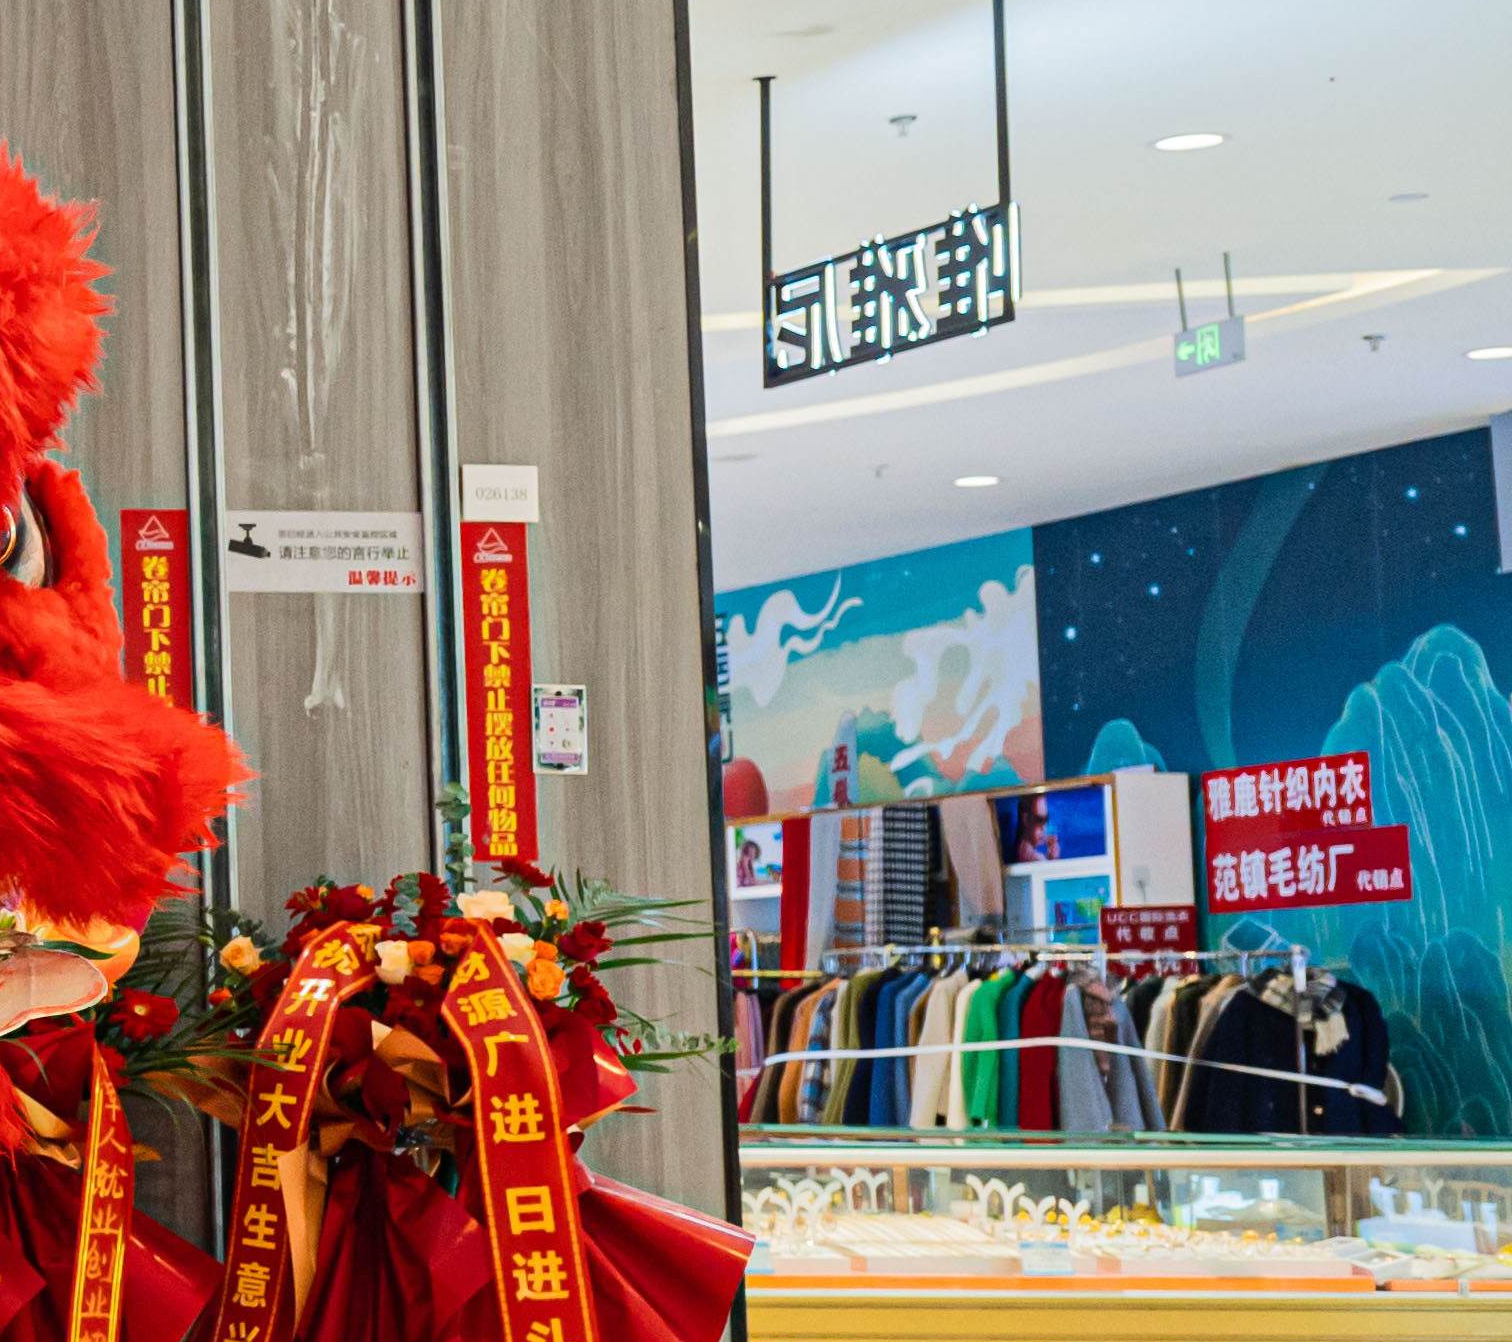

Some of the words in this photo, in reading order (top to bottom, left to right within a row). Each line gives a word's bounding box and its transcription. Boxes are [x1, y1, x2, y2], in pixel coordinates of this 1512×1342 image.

[475, 487, 529, 502] 026138
[279, 545, 410, 561] 请注意您的言行举止
[348, 570, 417, 587] 温馨提示
[480, 568, 518, 857] 卷帘门下禁止摆放任何物品
[1207, 759, 1367, 822] 雅鹿针织内衣
[1213, 844, 1355, 903] 范镇毛纺厂
